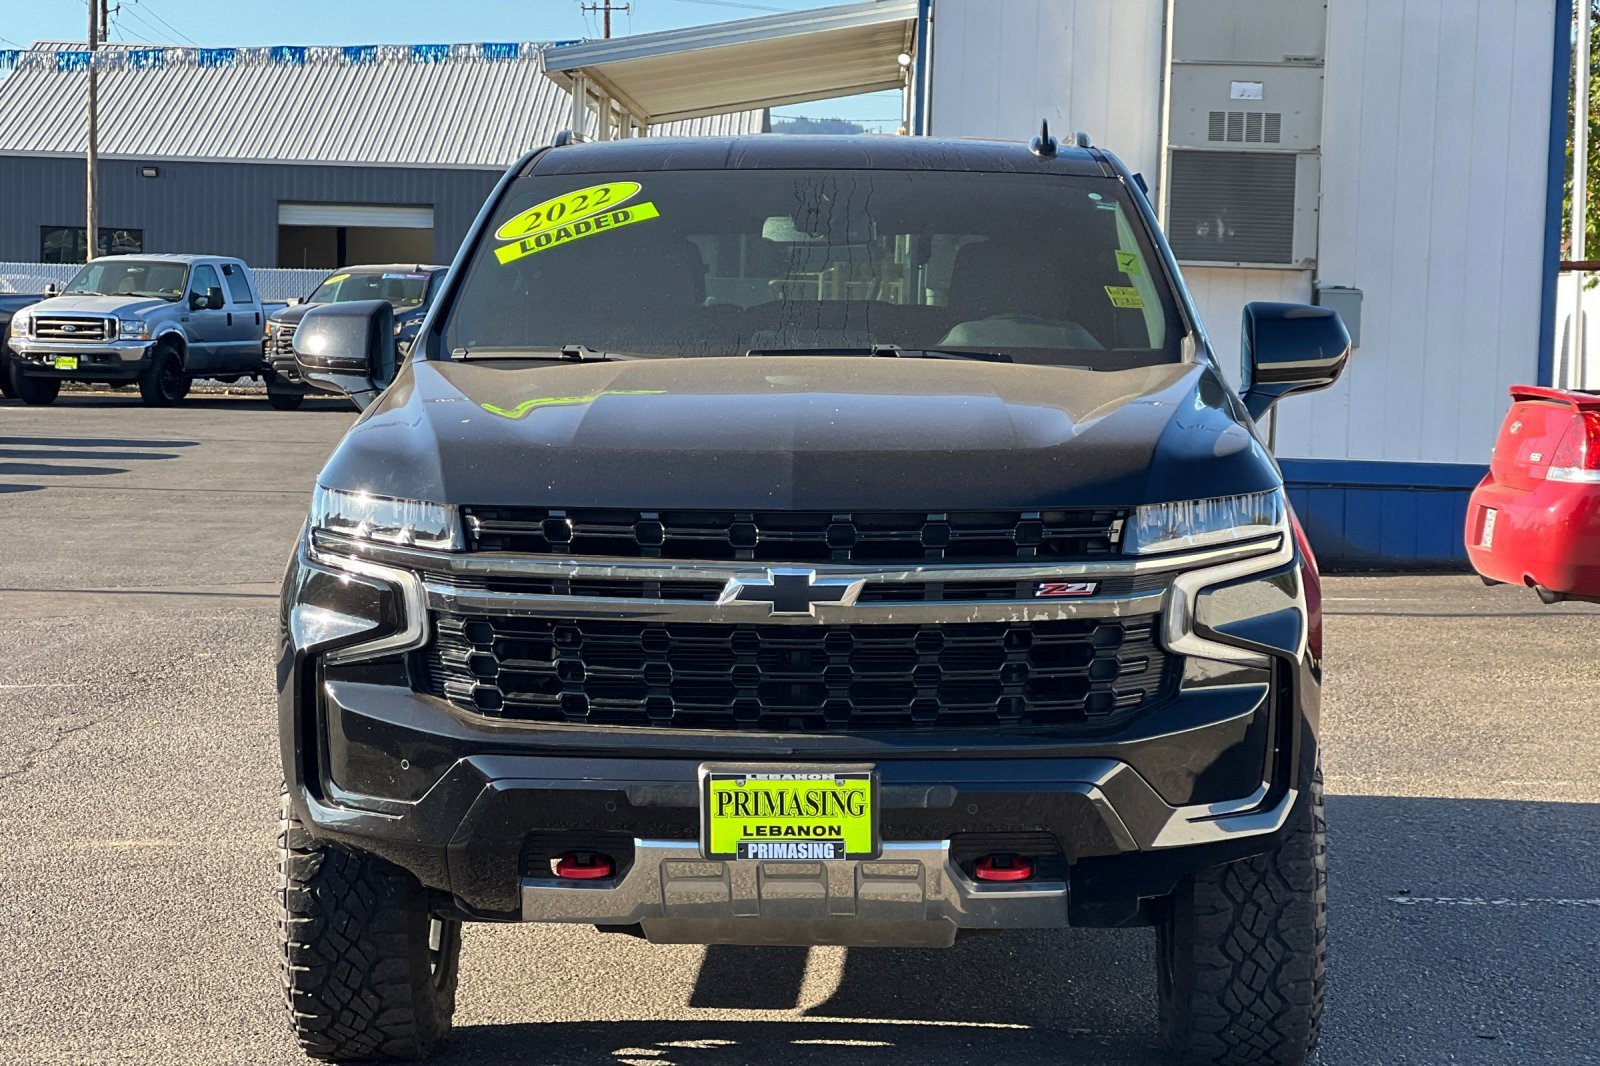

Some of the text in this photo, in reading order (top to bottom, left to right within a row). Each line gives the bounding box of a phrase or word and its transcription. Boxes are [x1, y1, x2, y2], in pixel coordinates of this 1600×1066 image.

[523, 187, 611, 233] 2022
[519, 210, 635, 254] LOADED
[1035, 582, 1098, 597] Z71
[714, 788, 868, 818] PRIMASING
[742, 825, 842, 837] LEBANON
[747, 843, 835, 859] PRIMASING
